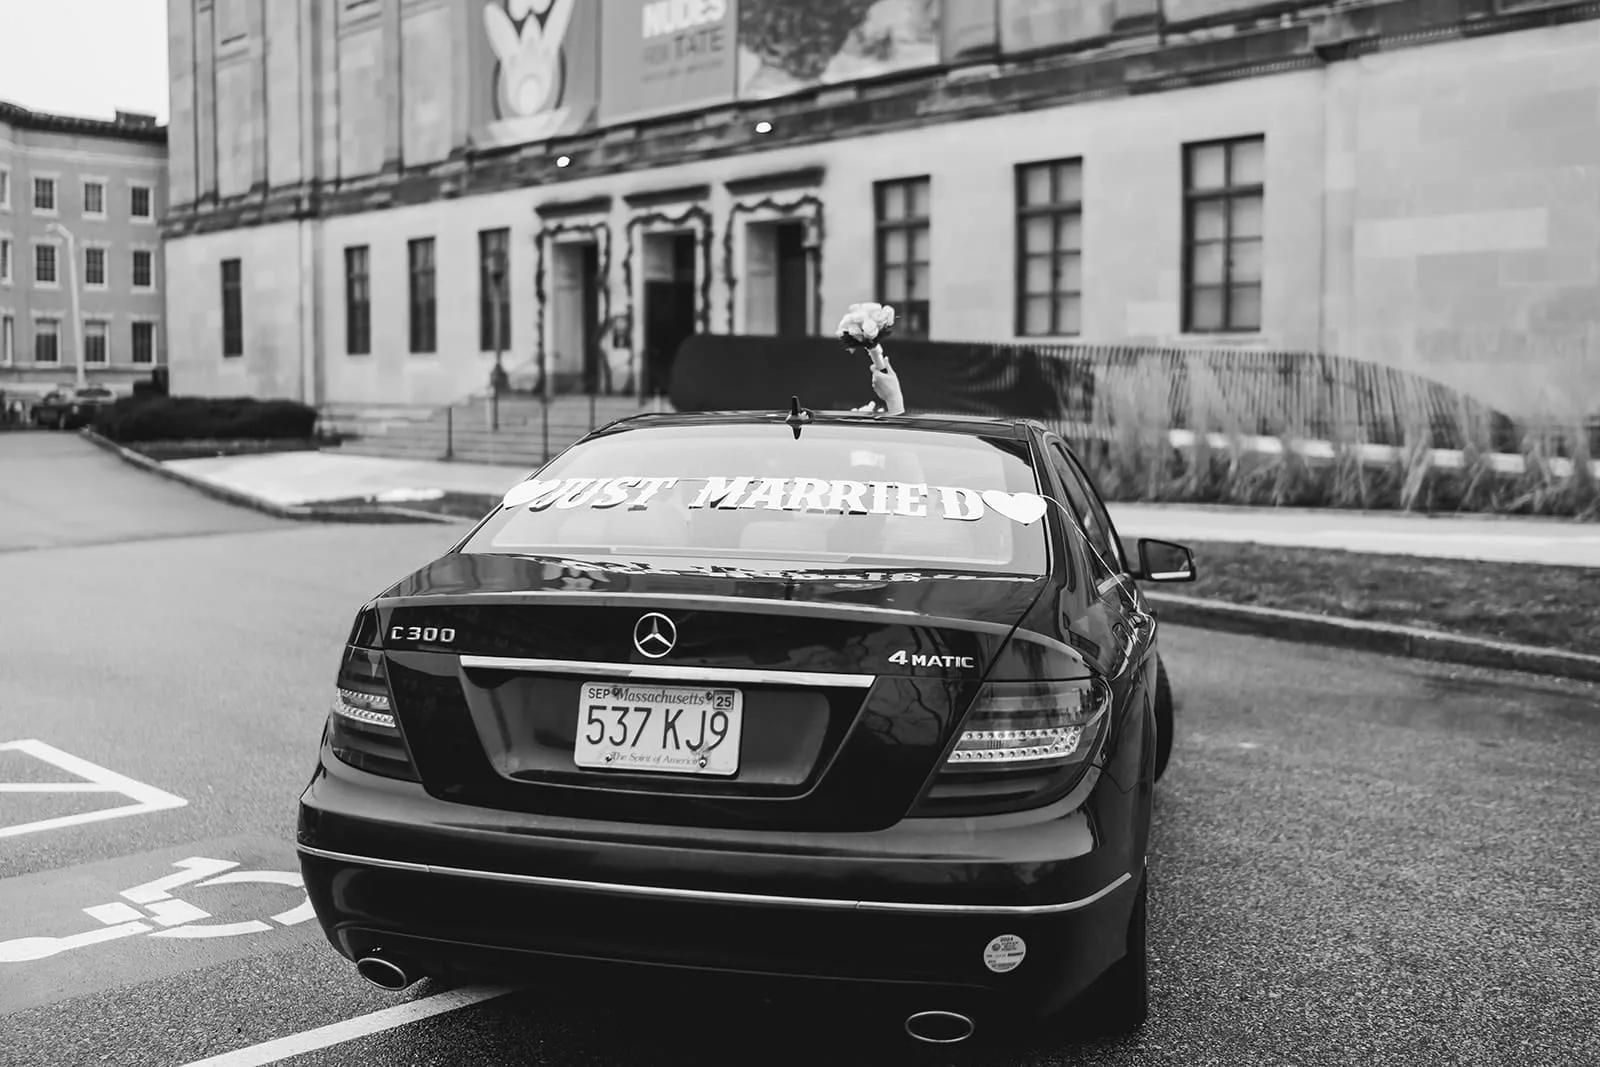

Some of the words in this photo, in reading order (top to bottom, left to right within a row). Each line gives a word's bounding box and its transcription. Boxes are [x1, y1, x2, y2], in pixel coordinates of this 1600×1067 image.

[529, 477, 680, 512] JUST
[688, 476, 985, 522] MARRIED
[887, 649, 975, 669] 4MATIC
[588, 687, 611, 699] SEP
[617, 687, 704, 705] Massachusetts
[716, 696, 732, 708] 25
[586, 704, 653, 748] 537
[662, 708, 729, 752] KJ9
[611, 751, 627, 761] The
[629, 753, 651, 764] Spirit
[653, 755, 662, 764] of
[663, 755, 699, 766] America
